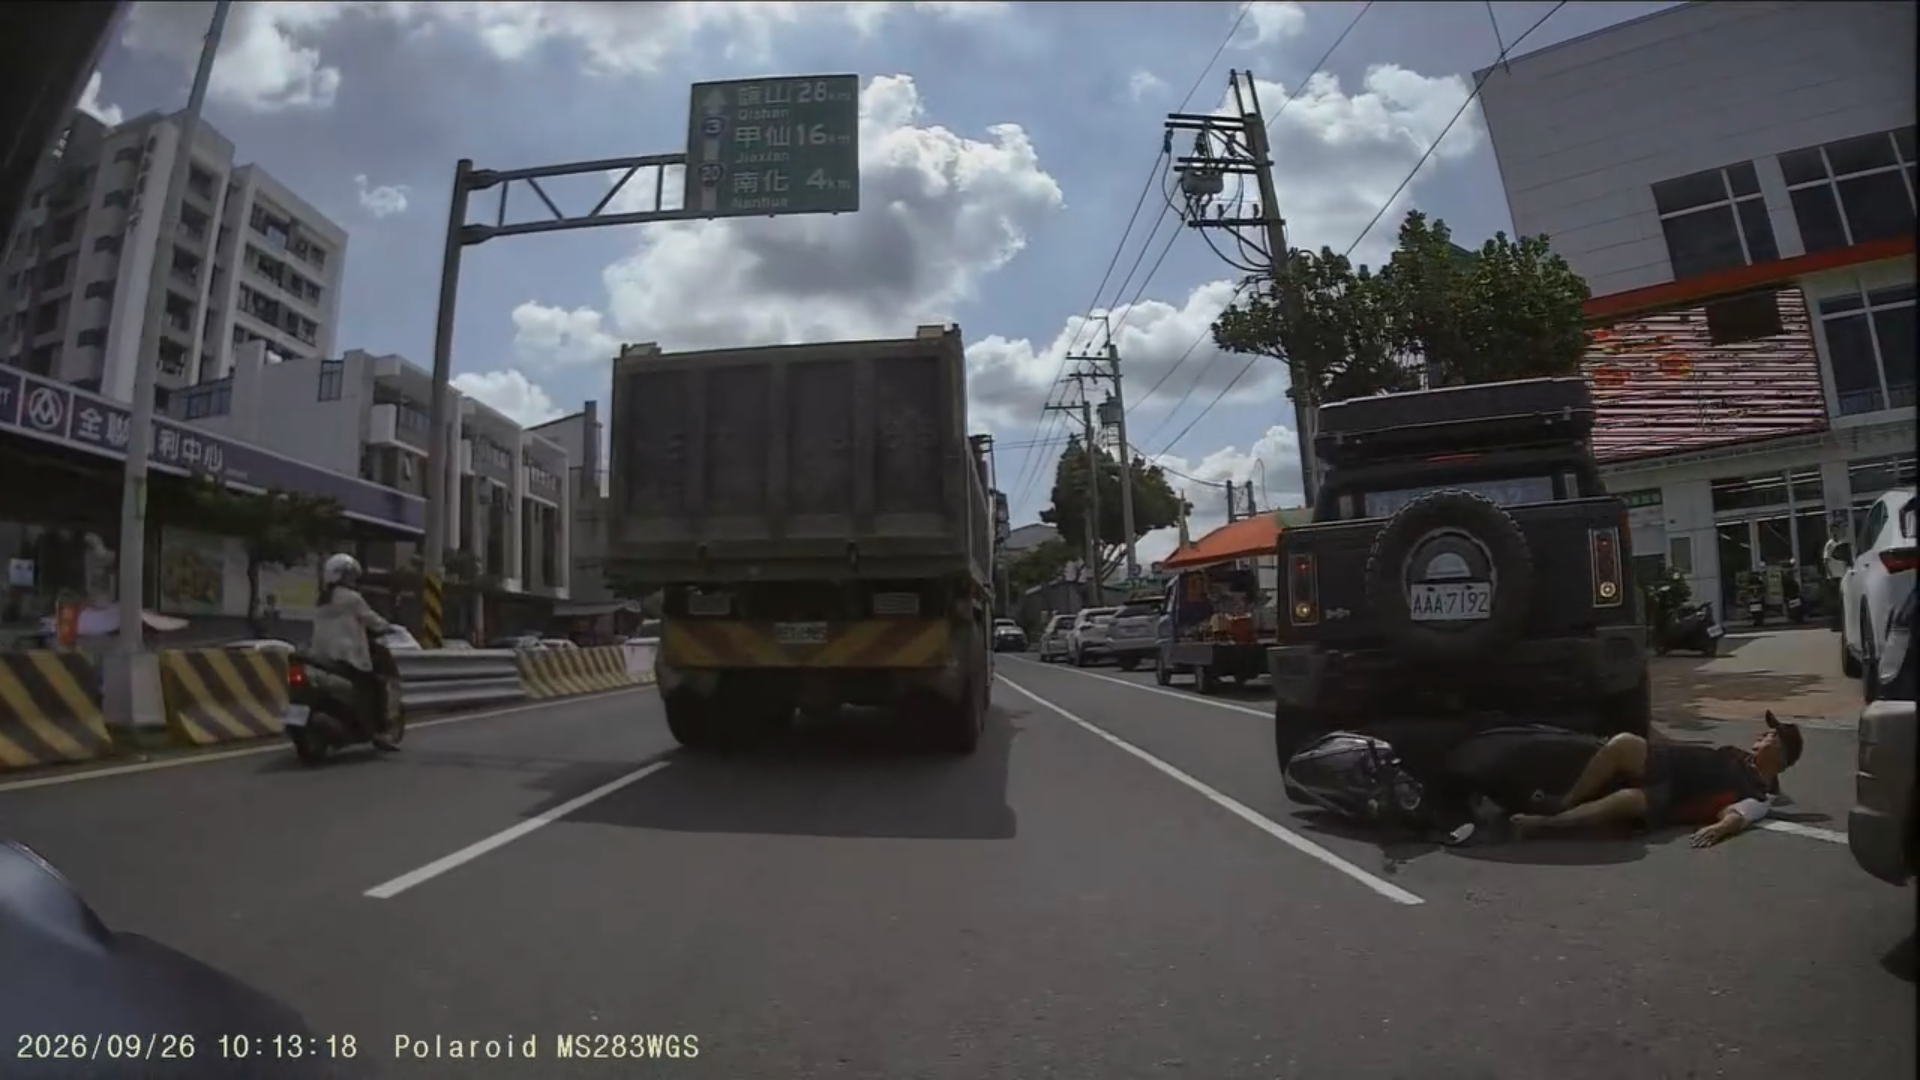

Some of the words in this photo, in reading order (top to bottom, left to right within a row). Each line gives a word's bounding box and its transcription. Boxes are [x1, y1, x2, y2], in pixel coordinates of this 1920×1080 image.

[737, 108, 790, 121] Qishan
[705, 119, 721, 134] 3
[735, 125, 790, 148] 甲仙
[735, 151, 790, 164] Jiaxian
[701, 166, 720, 181] 20
[733, 169, 789, 193] 南化
[78, 404, 224, 477] 全聯利中心
